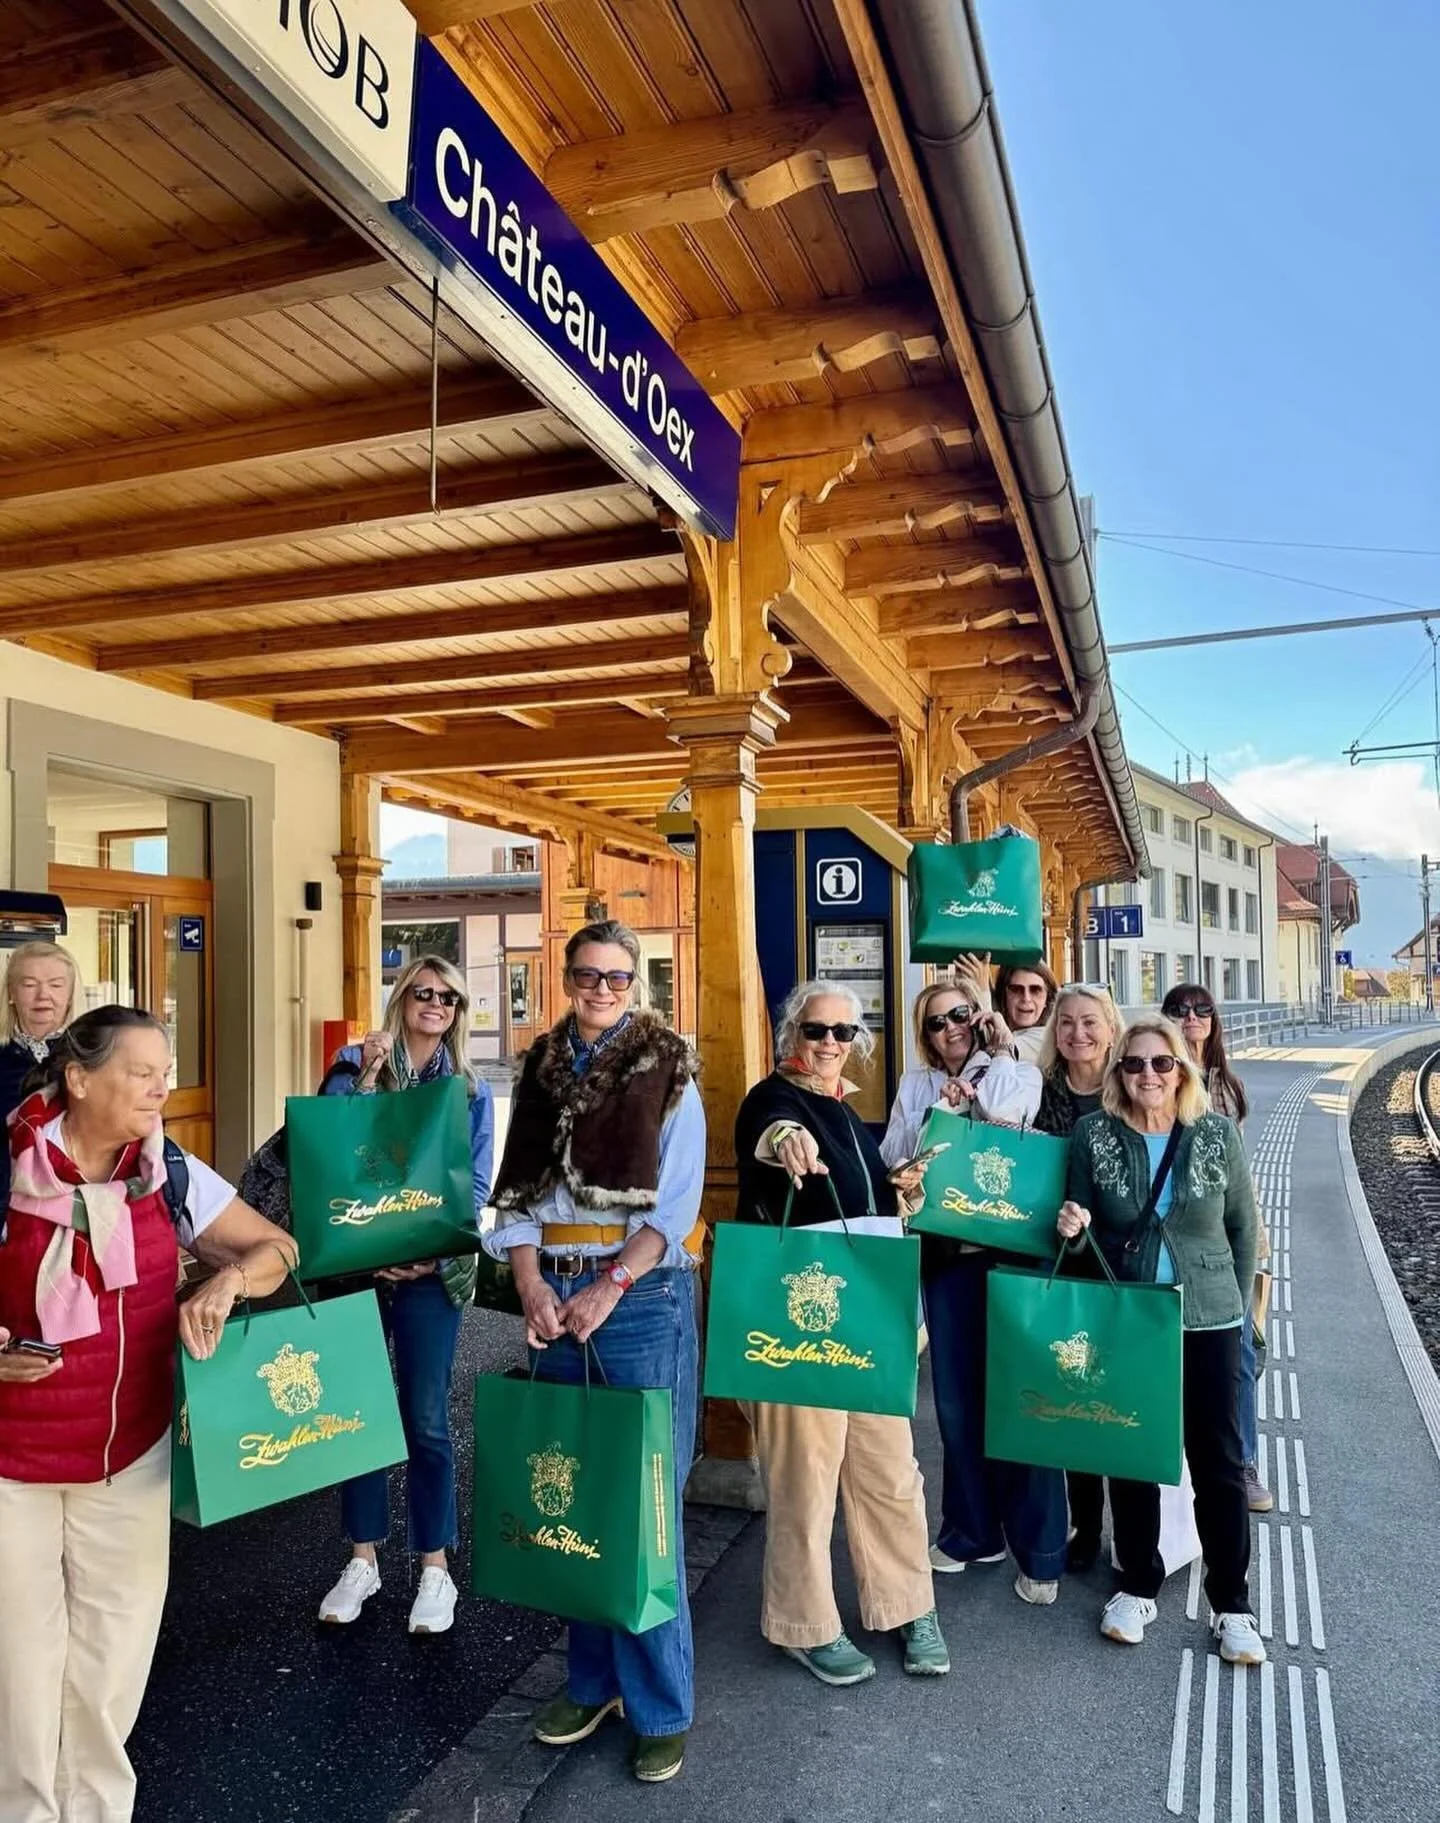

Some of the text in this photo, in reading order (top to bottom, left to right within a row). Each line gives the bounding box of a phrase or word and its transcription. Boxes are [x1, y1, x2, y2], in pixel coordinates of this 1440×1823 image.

[279, 0, 389, 129] OB
[436, 127, 695, 472] Château-d'Oex
[1121, 915, 1128, 932] 1
